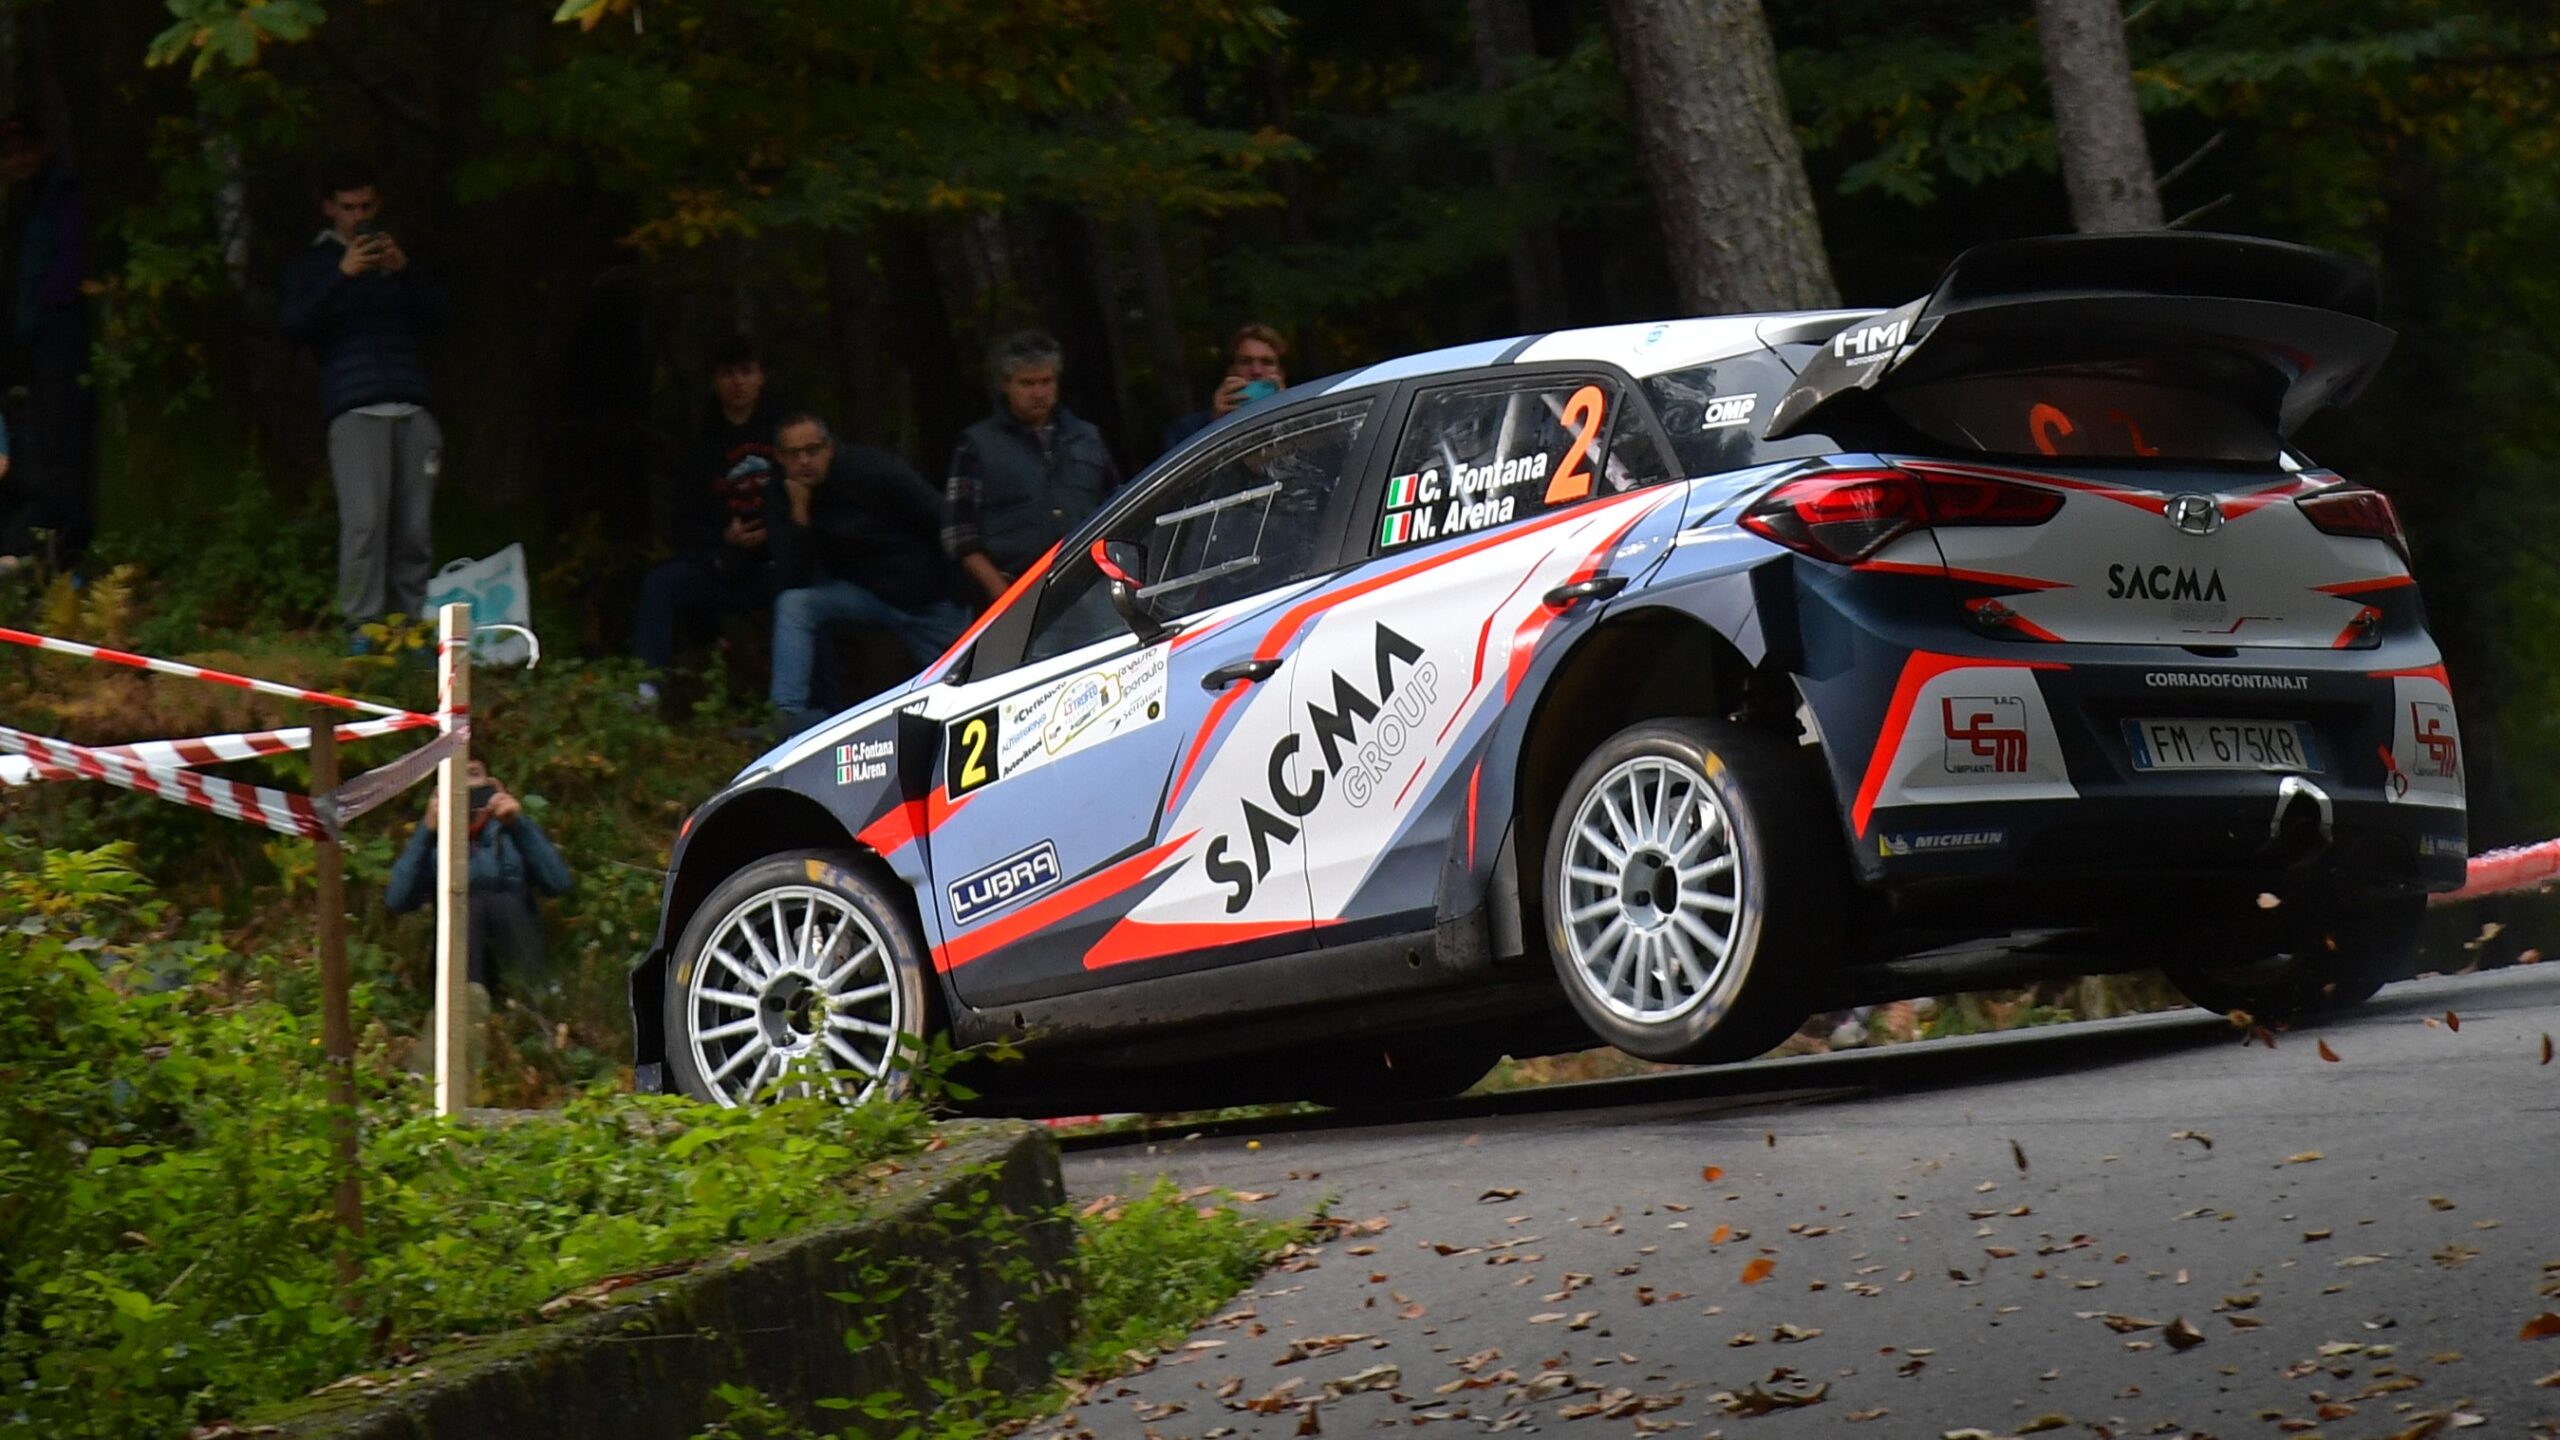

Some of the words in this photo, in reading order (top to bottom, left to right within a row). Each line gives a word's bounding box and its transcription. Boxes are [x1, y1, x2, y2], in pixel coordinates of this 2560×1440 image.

[1834, 319, 1909, 358] HMI
[1704, 397, 1756, 424] OMP
[1544, 385, 1605, 505] 2
[1418, 469, 1442, 502] C.
[1450, 452, 1549, 498] Fontana
[1411, 506, 1437, 541] N.
[1442, 496, 1515, 536] Arena
[2107, 563, 2227, 601] SACMA
[2145, 672, 2309, 690] CORRADOFONTANA.IT
[960, 718, 989, 789] 2
[1342, 661, 1438, 809] GROUP
[2150, 725, 2196, 763] FM
[2209, 726, 2301, 765] 675KR
[1205, 620, 1425, 914] SACMA
[1915, 832, 2004, 848] MICHELIN
[952, 849, 1057, 913] LUBRA
